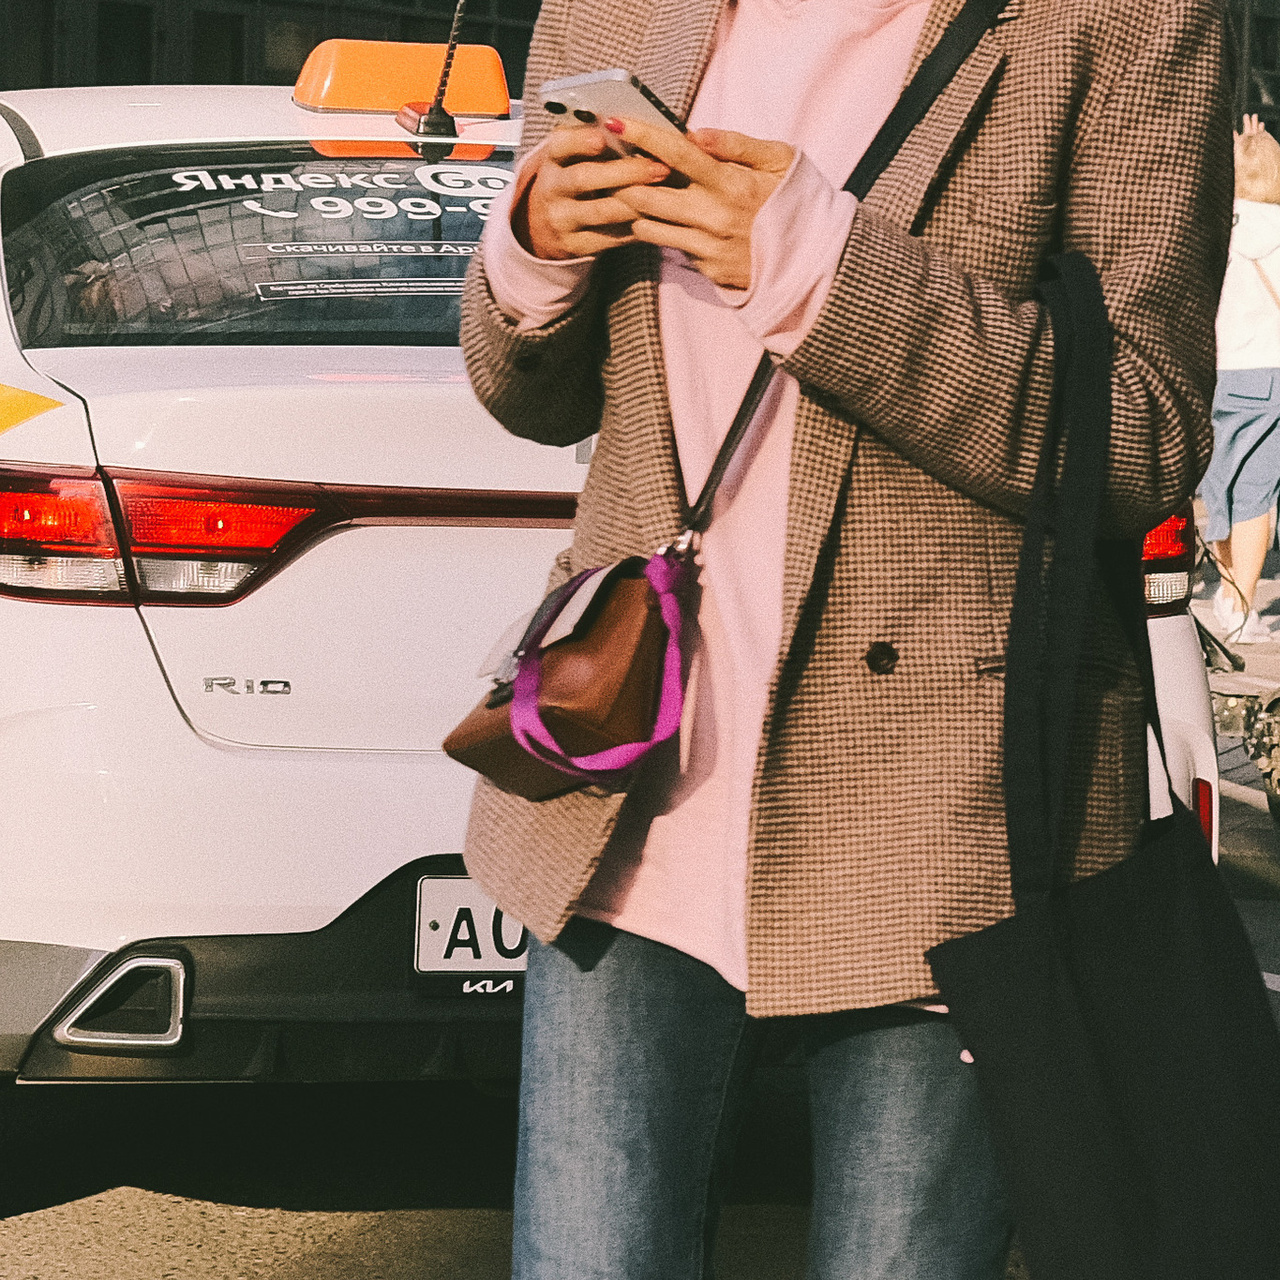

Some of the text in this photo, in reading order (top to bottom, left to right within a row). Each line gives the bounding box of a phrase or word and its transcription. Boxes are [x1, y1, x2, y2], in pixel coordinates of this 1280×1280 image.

[172, 169, 513, 192] Яндекс Go
[266, 243, 416, 255] Скачивайте
[420, 245, 434, 254] в
